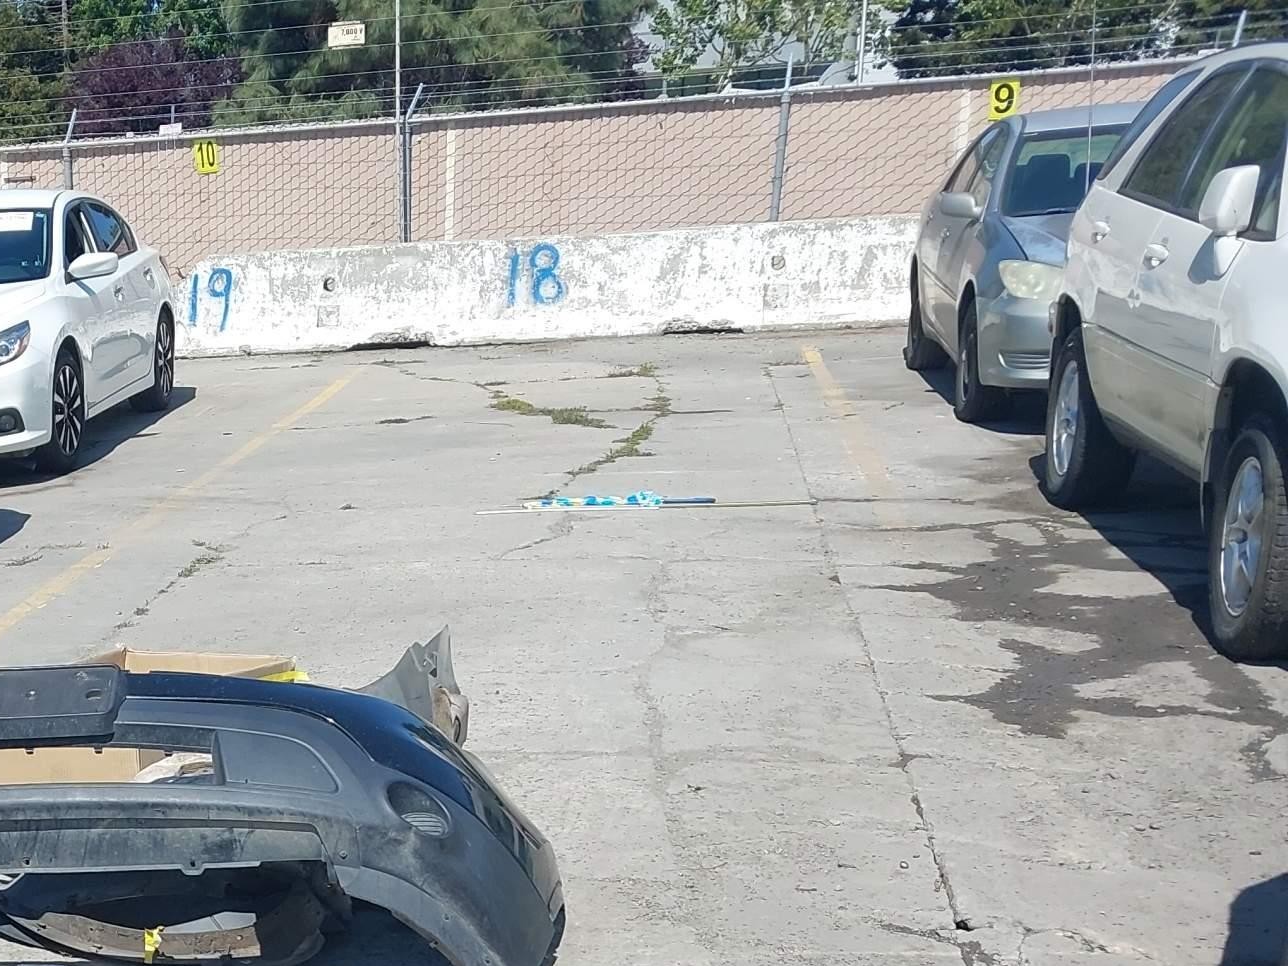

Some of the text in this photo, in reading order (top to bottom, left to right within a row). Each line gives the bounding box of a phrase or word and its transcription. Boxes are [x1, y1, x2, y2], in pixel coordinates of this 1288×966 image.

[994, 83, 1014, 114] 9
[197, 141, 215, 168] 10
[508, 243, 565, 305] 18
[189, 268, 232, 332] 19
